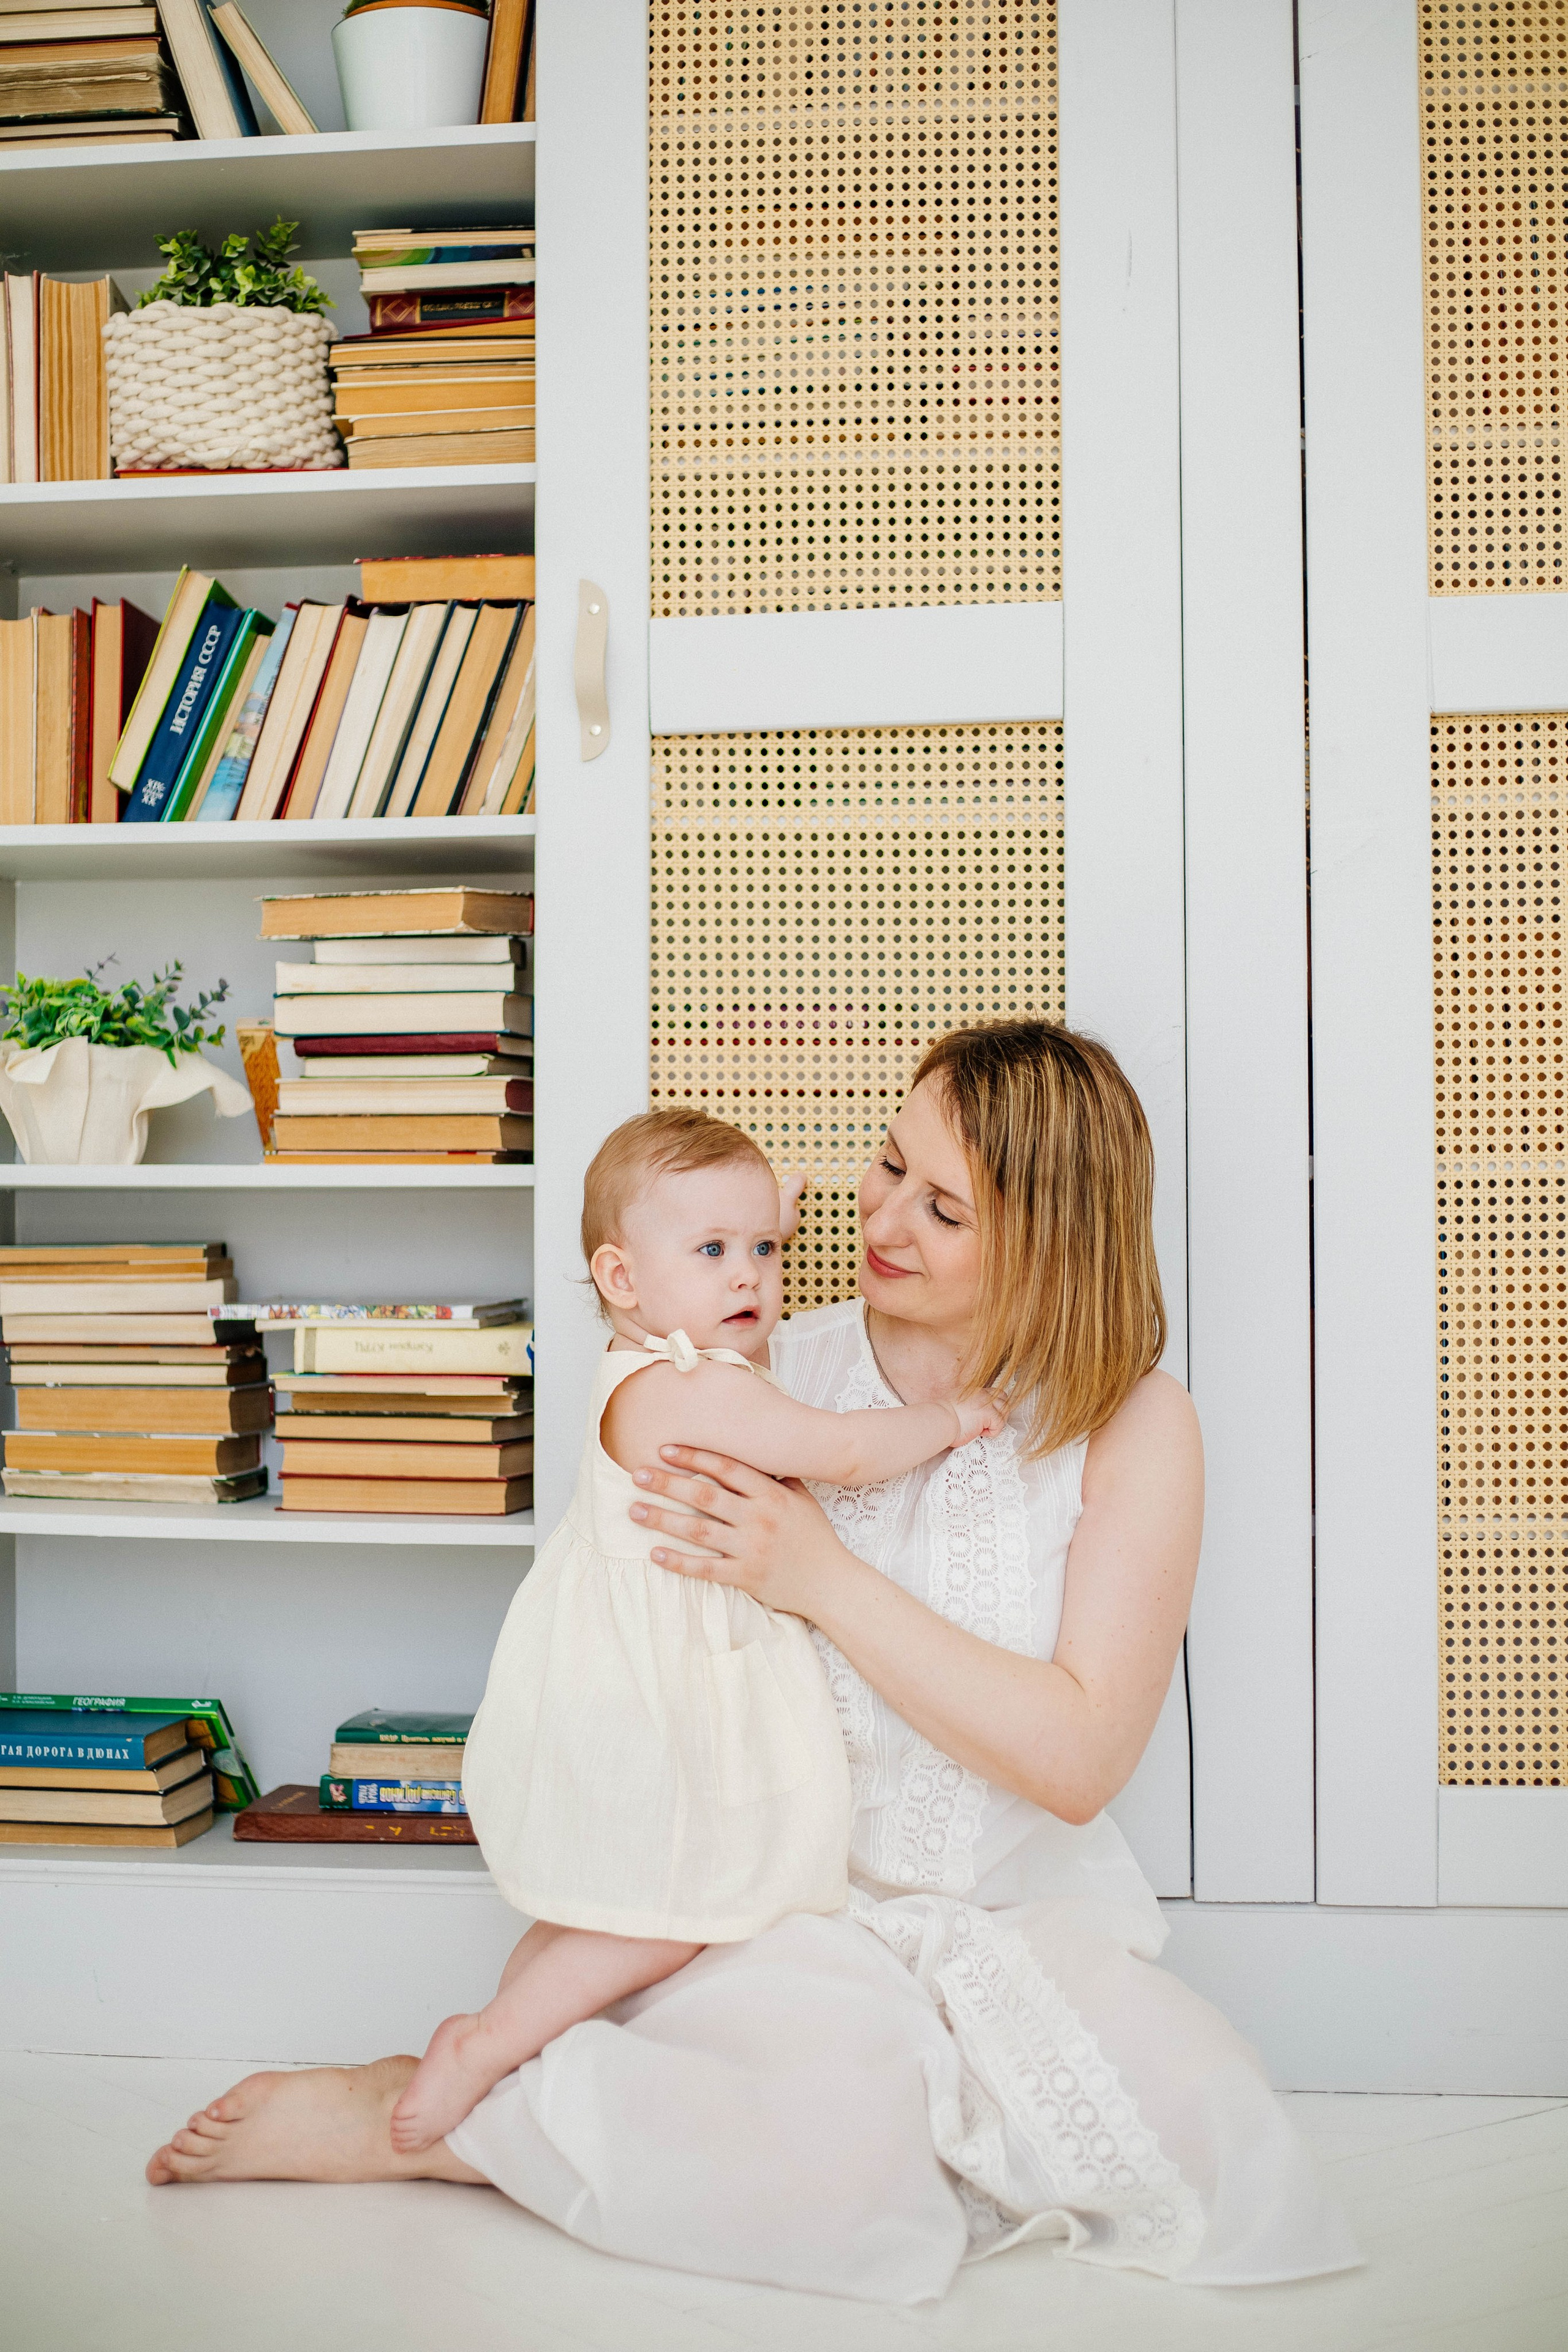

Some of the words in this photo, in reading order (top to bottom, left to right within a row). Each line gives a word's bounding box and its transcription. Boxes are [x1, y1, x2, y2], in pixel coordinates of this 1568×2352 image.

[170, 665, 207, 735] ИСТОРИЯ
[198, 625, 221, 665] СССР
[72, 1697, 126, 1706] ГЕОГРАФИЯ
[26, 1746, 74, 1758] ДОРОГА
[77, 1747, 85, 1758] В
[87, 1747, 129, 1760] ДЮНАХ
